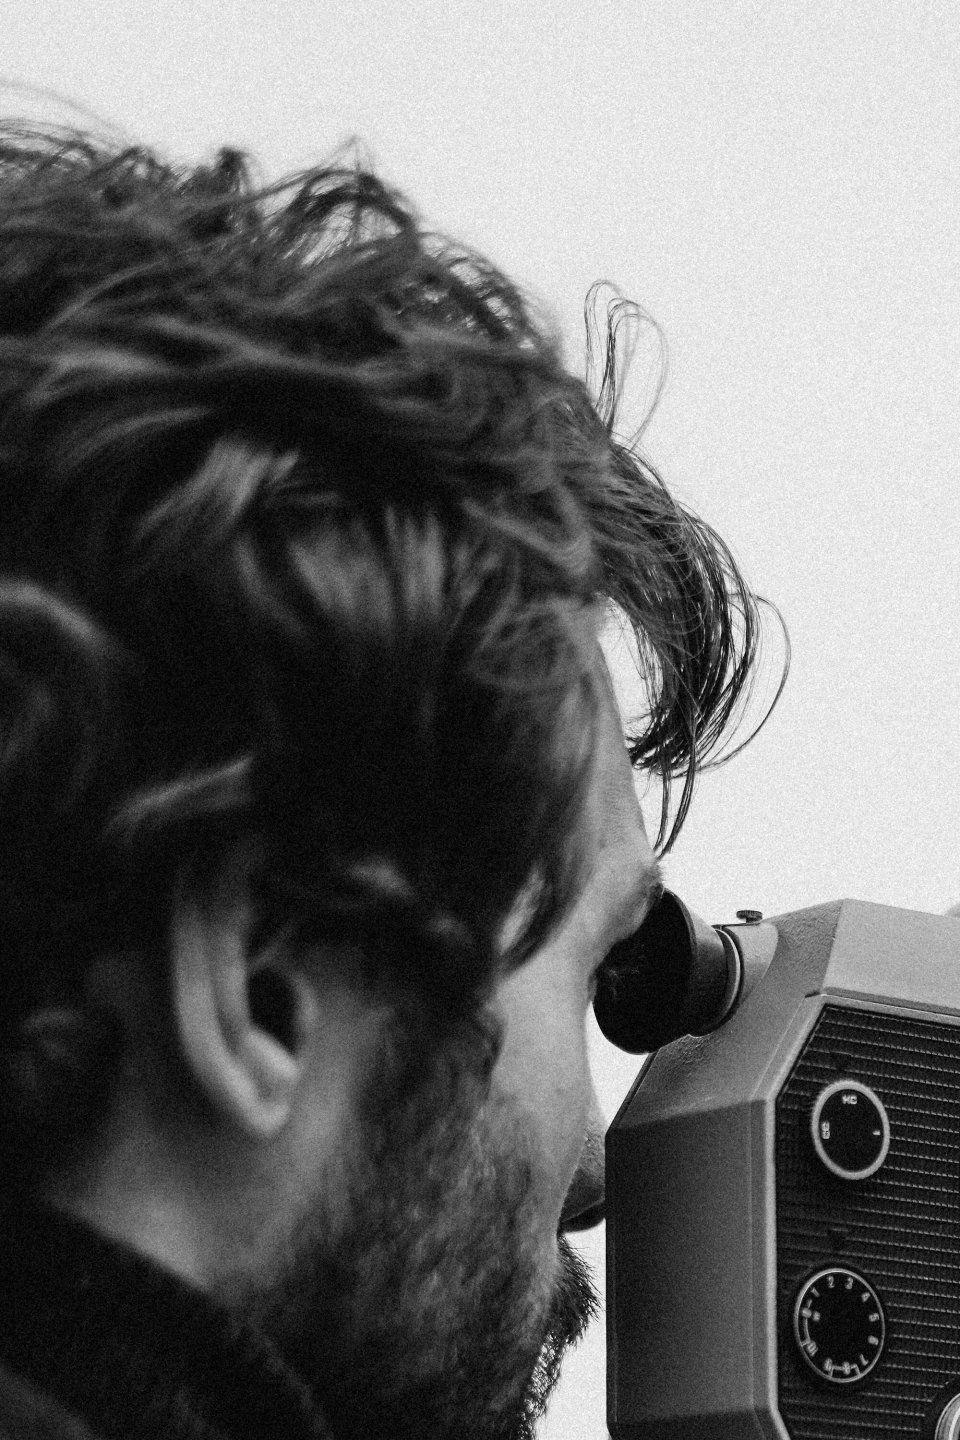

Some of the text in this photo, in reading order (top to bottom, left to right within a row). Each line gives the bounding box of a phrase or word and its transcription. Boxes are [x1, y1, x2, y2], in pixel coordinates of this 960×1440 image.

[827, 1275, 835, 1289] 2
[845, 1277, 854, 1290] 3
[868, 1312, 880, 1322] 5
[860, 1353, 869, 1366] 7
